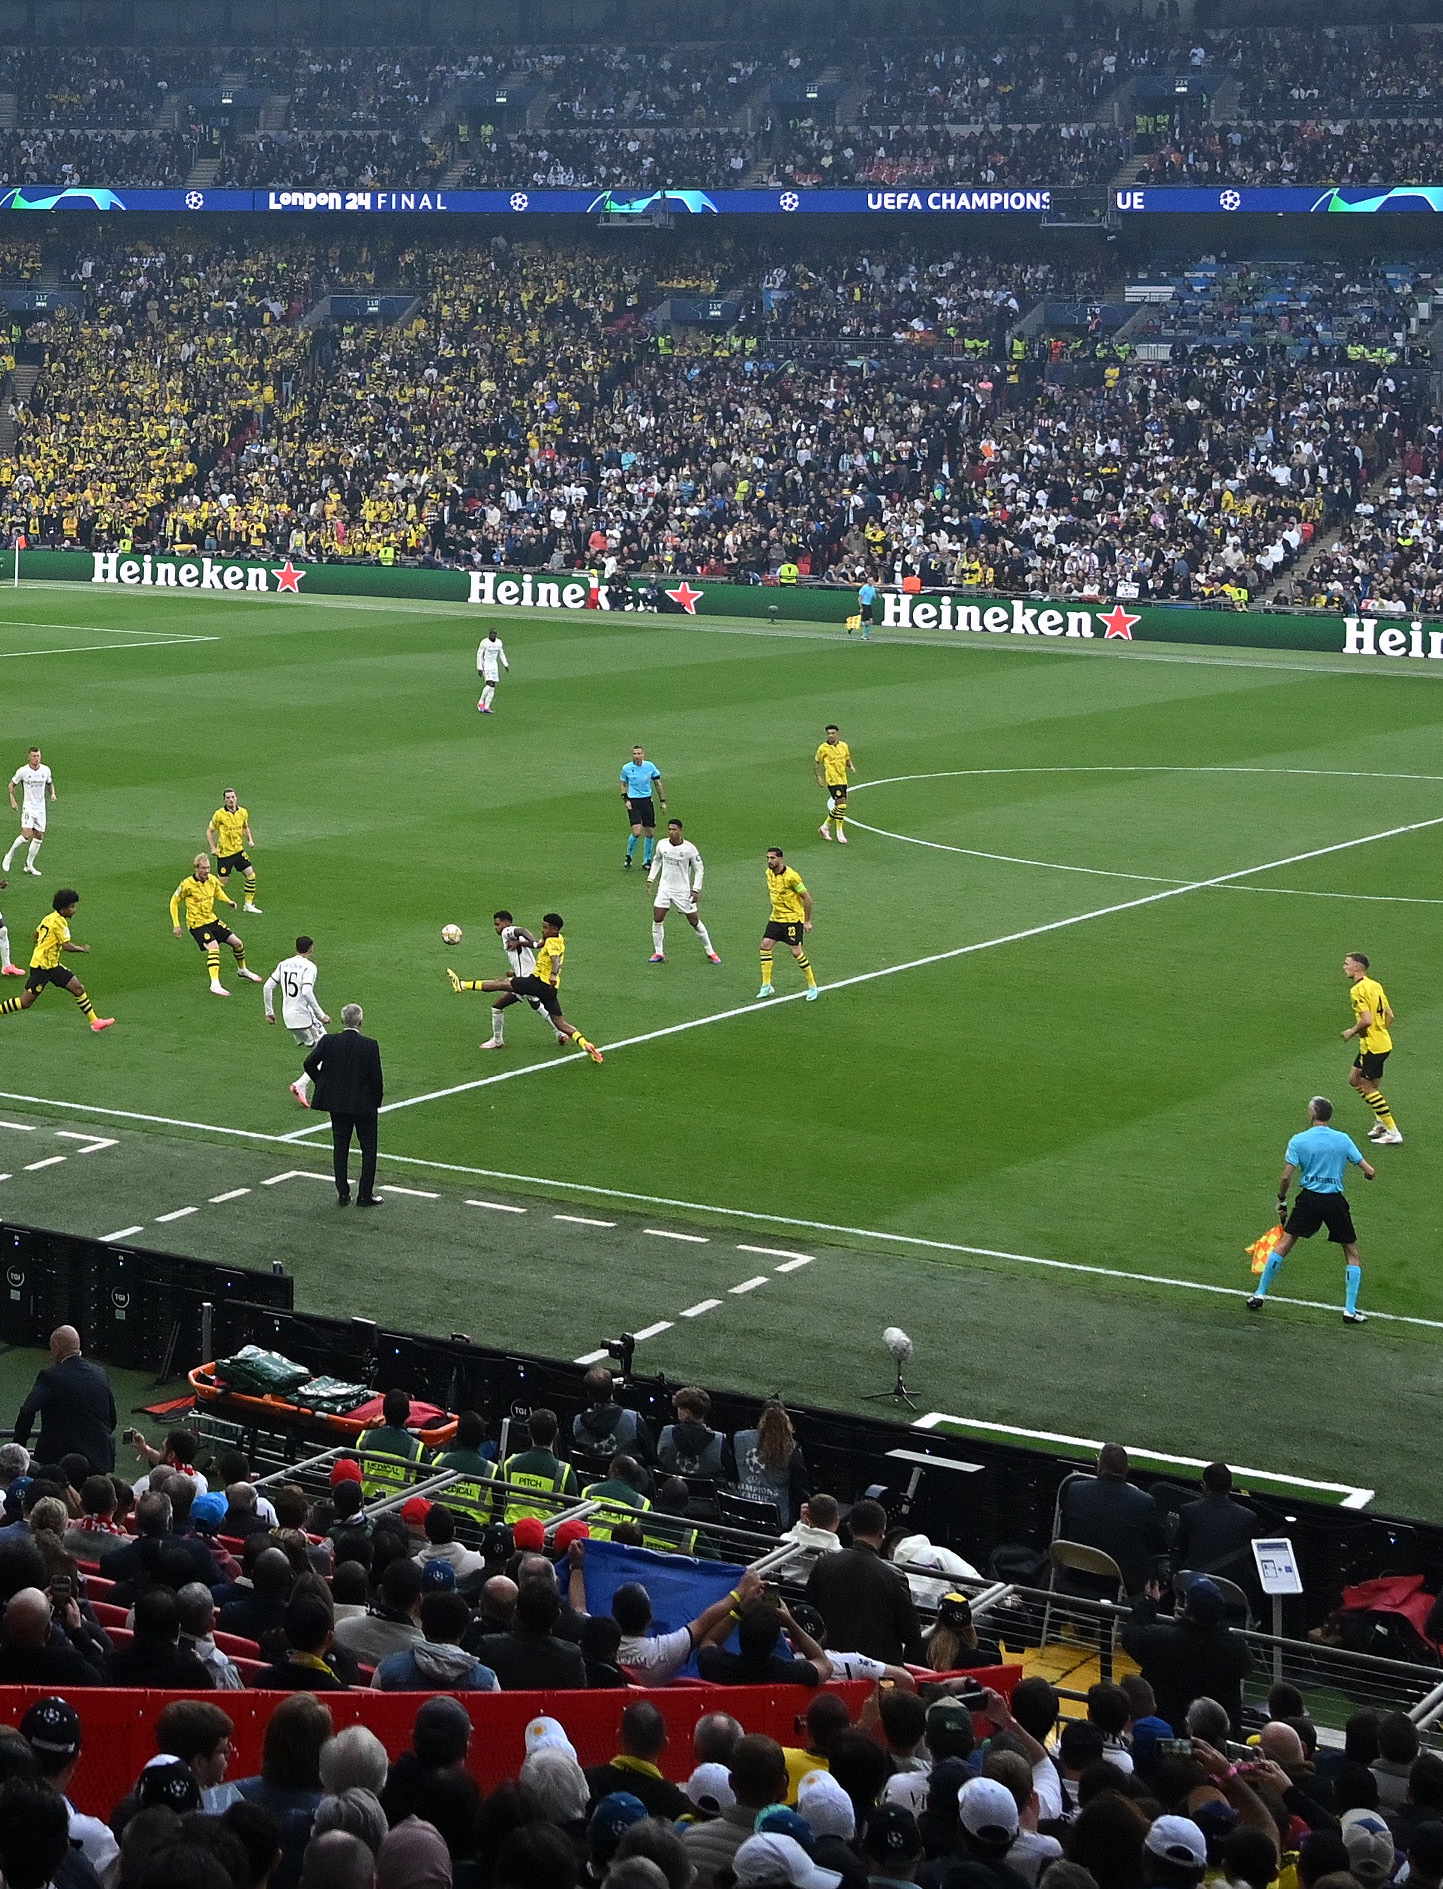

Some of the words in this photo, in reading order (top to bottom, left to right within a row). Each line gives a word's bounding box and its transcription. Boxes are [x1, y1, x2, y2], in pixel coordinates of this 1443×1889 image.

[268, 191, 340, 210] London
[344, 192, 371, 210] 24
[378, 194, 447, 210] FINAL
[868, 193, 923, 210] UEFA
[928, 192, 1050, 210] CHAMPIONS
[92, 549, 270, 593] Heineken
[881, 591, 1095, 640] Heineken
[284, 971, 299, 999] 15
[1376, 996, 1383, 1016] 4
[366, 1462, 400, 1475] MEDICAL
[518, 1476, 542, 1489] PITCH
